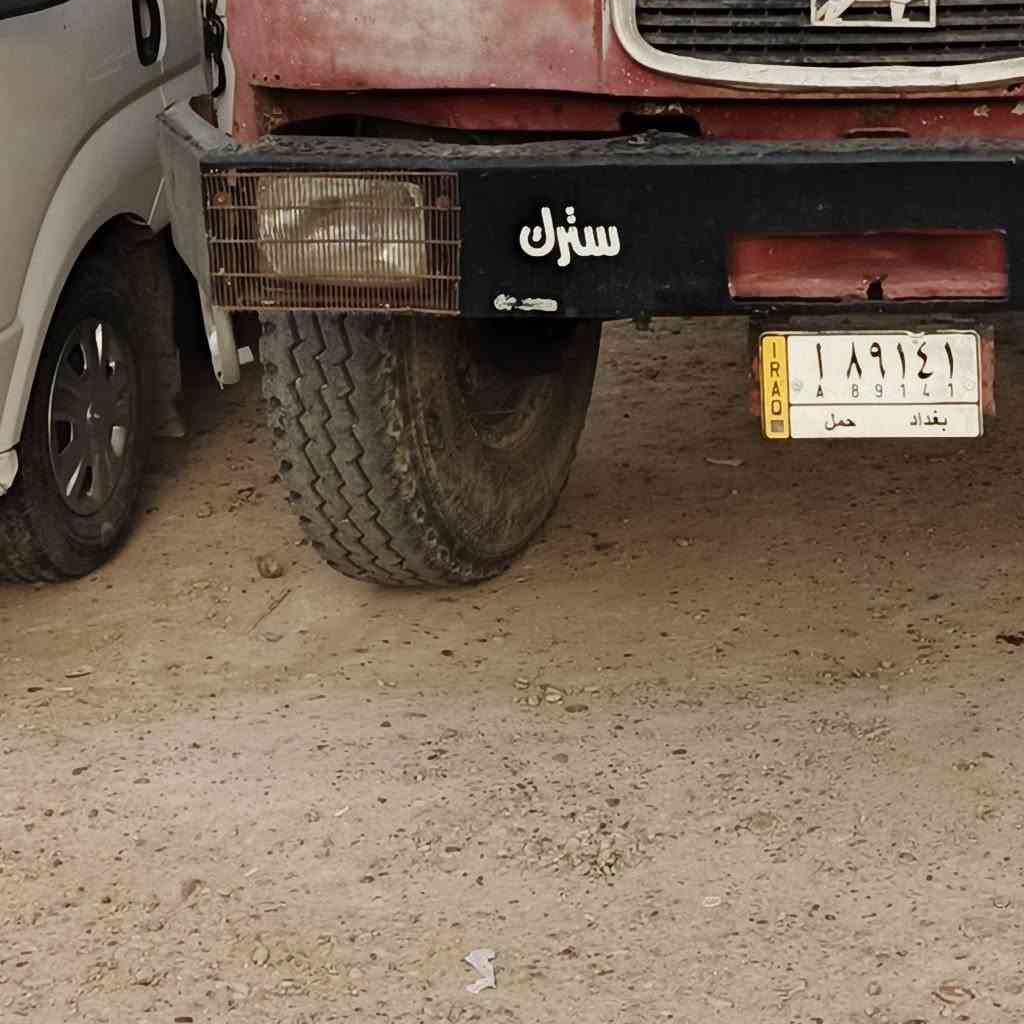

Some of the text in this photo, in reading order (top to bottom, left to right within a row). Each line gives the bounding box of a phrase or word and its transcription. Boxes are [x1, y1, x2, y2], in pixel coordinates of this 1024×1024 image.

[519, 206, 621, 267] سترك
[824, 409, 949, 432] بغداد حمل
